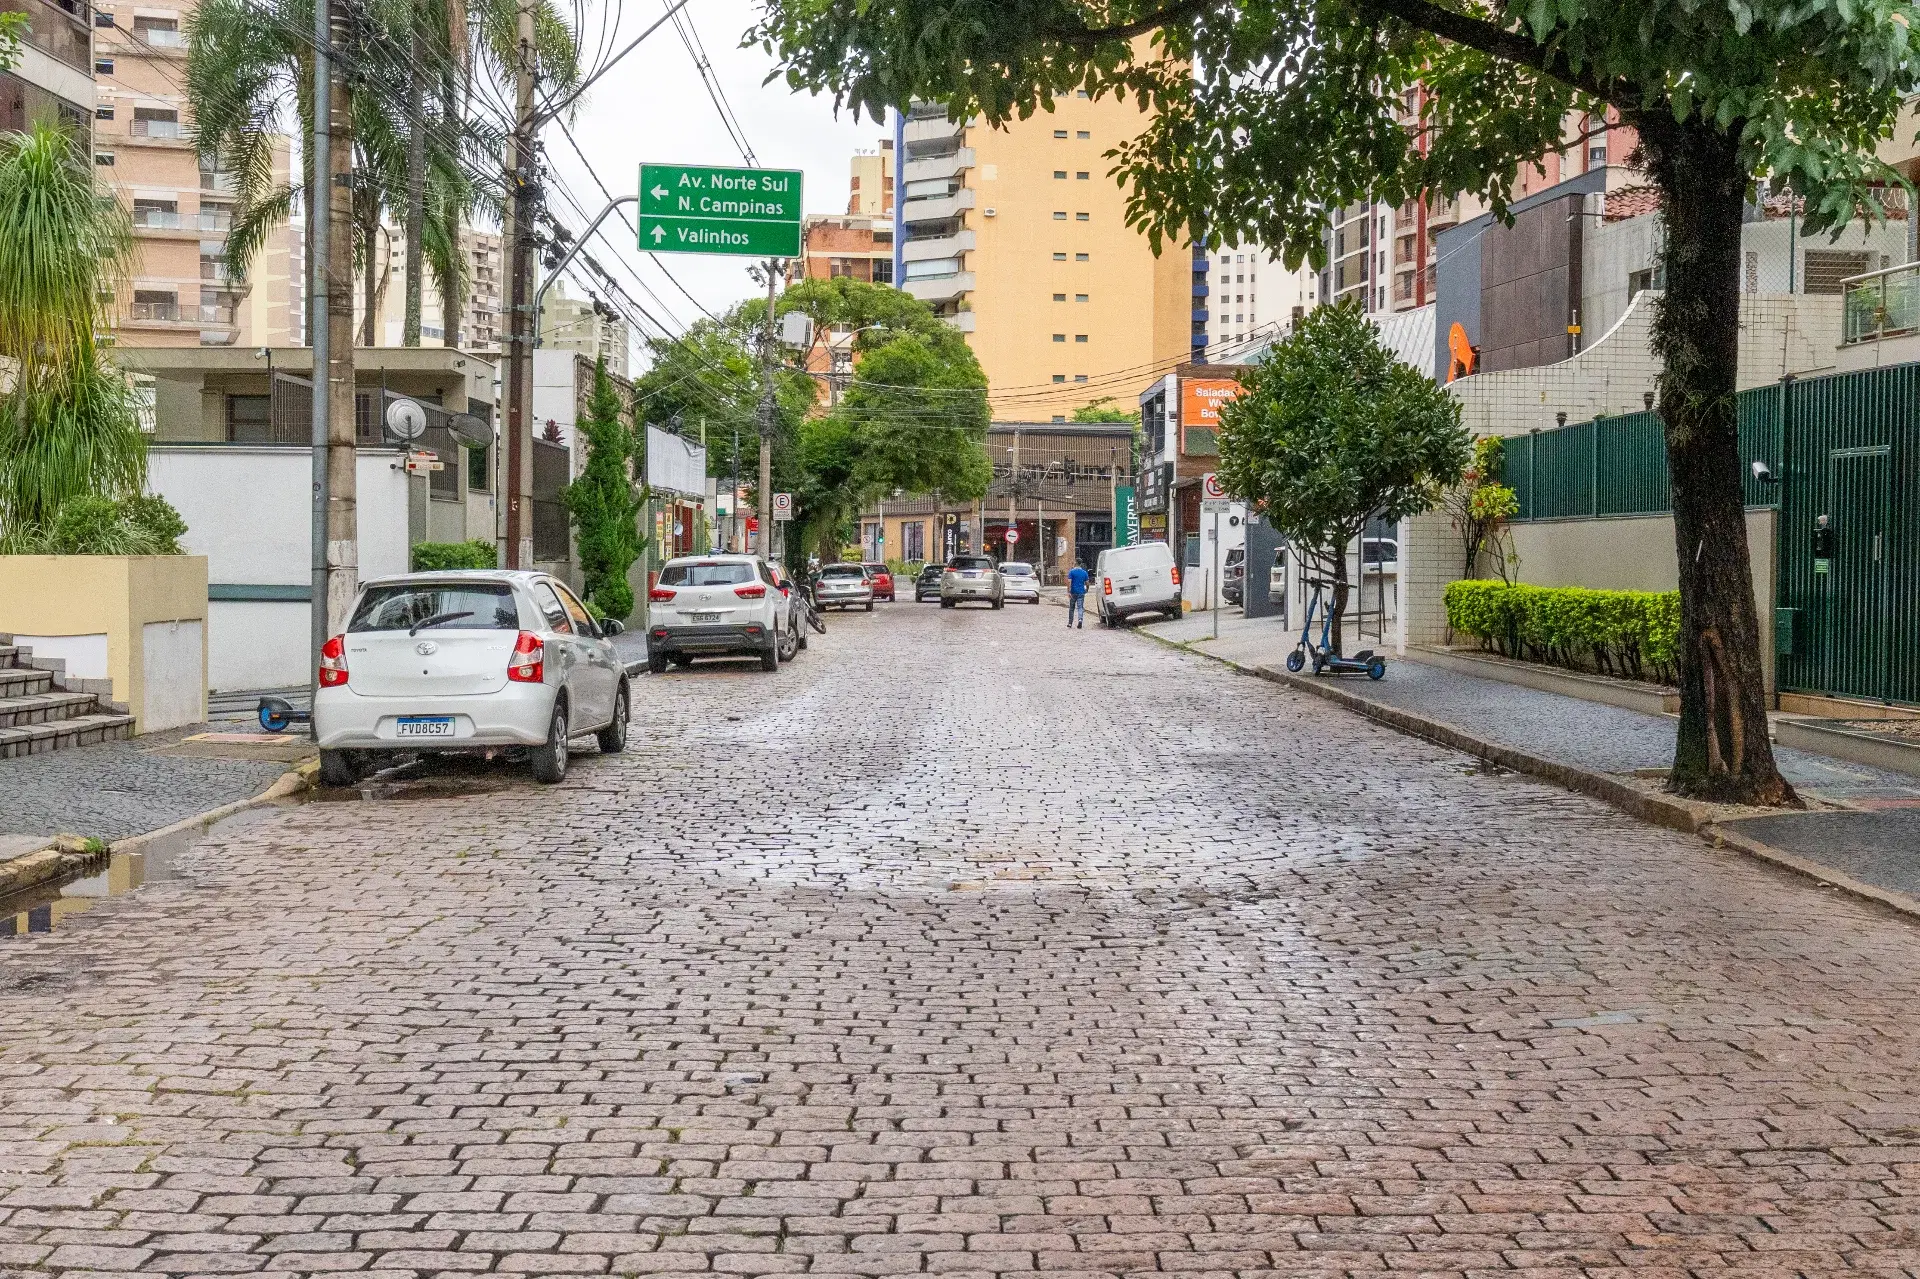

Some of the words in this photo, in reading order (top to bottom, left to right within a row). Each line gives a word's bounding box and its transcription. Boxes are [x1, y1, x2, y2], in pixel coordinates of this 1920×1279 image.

[678, 172, 706, 189] Av.
[711, 174, 756, 190] Norte
[762, 176, 788, 192] Sul
[678, 196, 694, 211] N.
[700, 197, 783, 216] Campinas
[677, 227, 749, 245] Valinhos
[401, 723, 448, 734] FVD8C57
